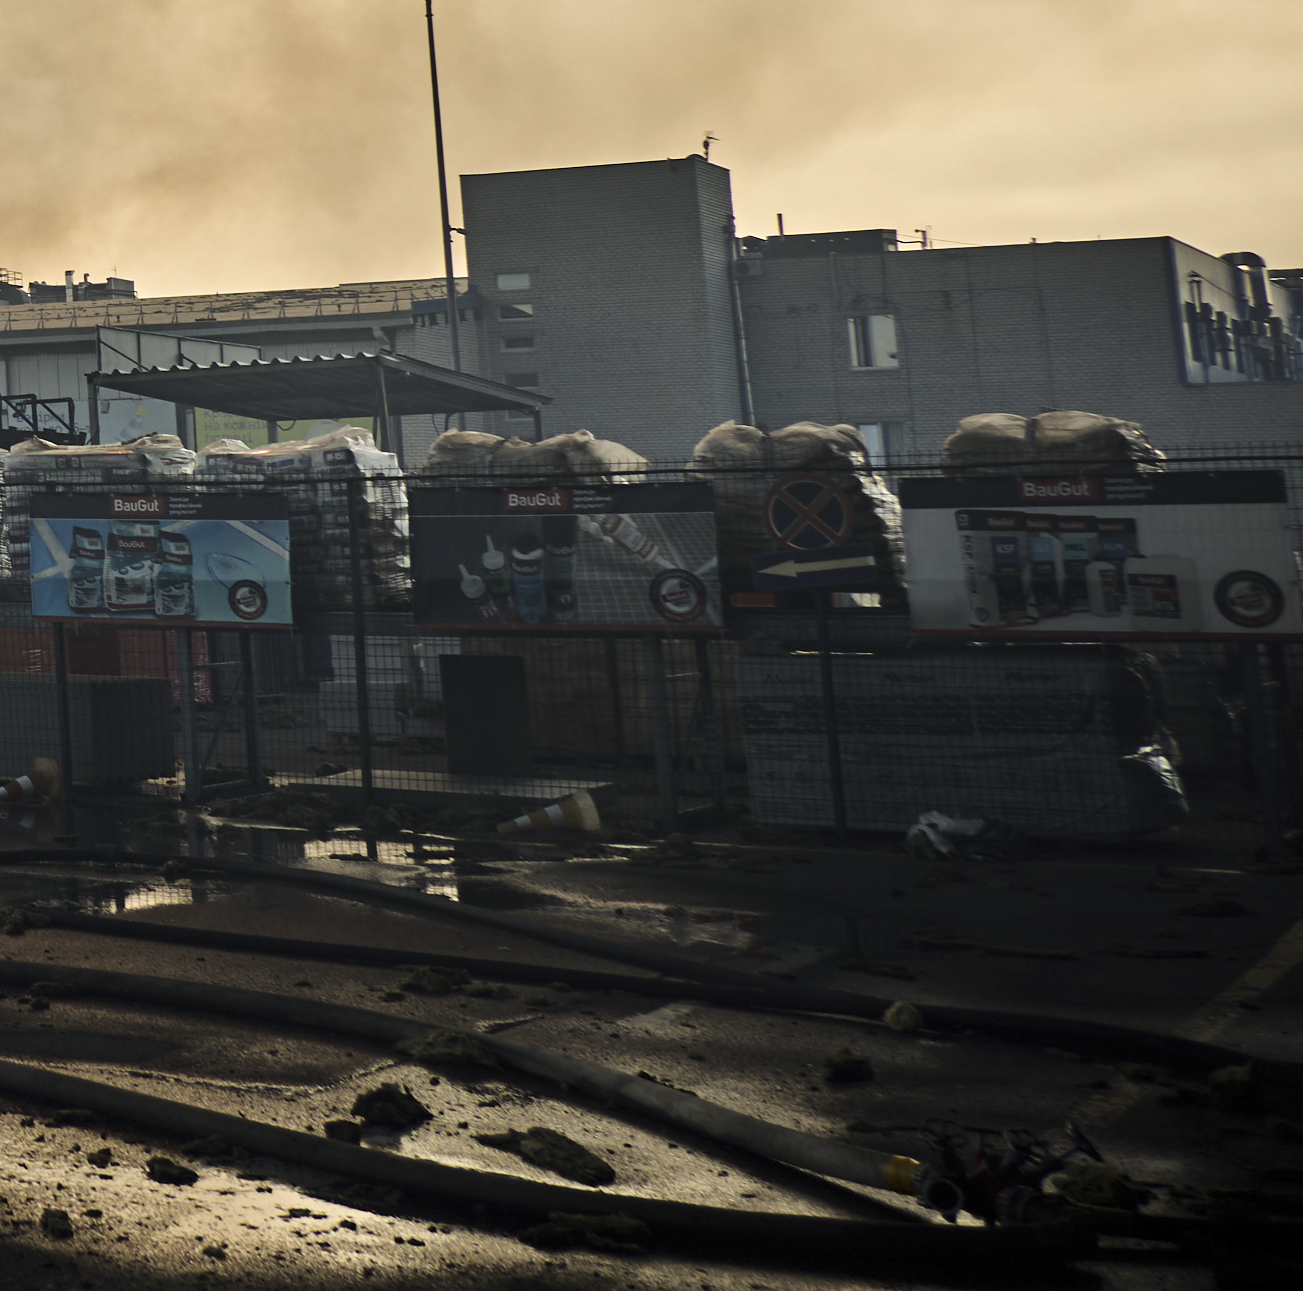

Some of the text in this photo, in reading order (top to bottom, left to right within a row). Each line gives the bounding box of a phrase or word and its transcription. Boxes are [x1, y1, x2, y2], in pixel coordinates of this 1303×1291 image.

[1023, 482, 1090, 498] BauGut
[114, 499, 160, 512] BauGut
[508, 493, 562, 507] BauGut
